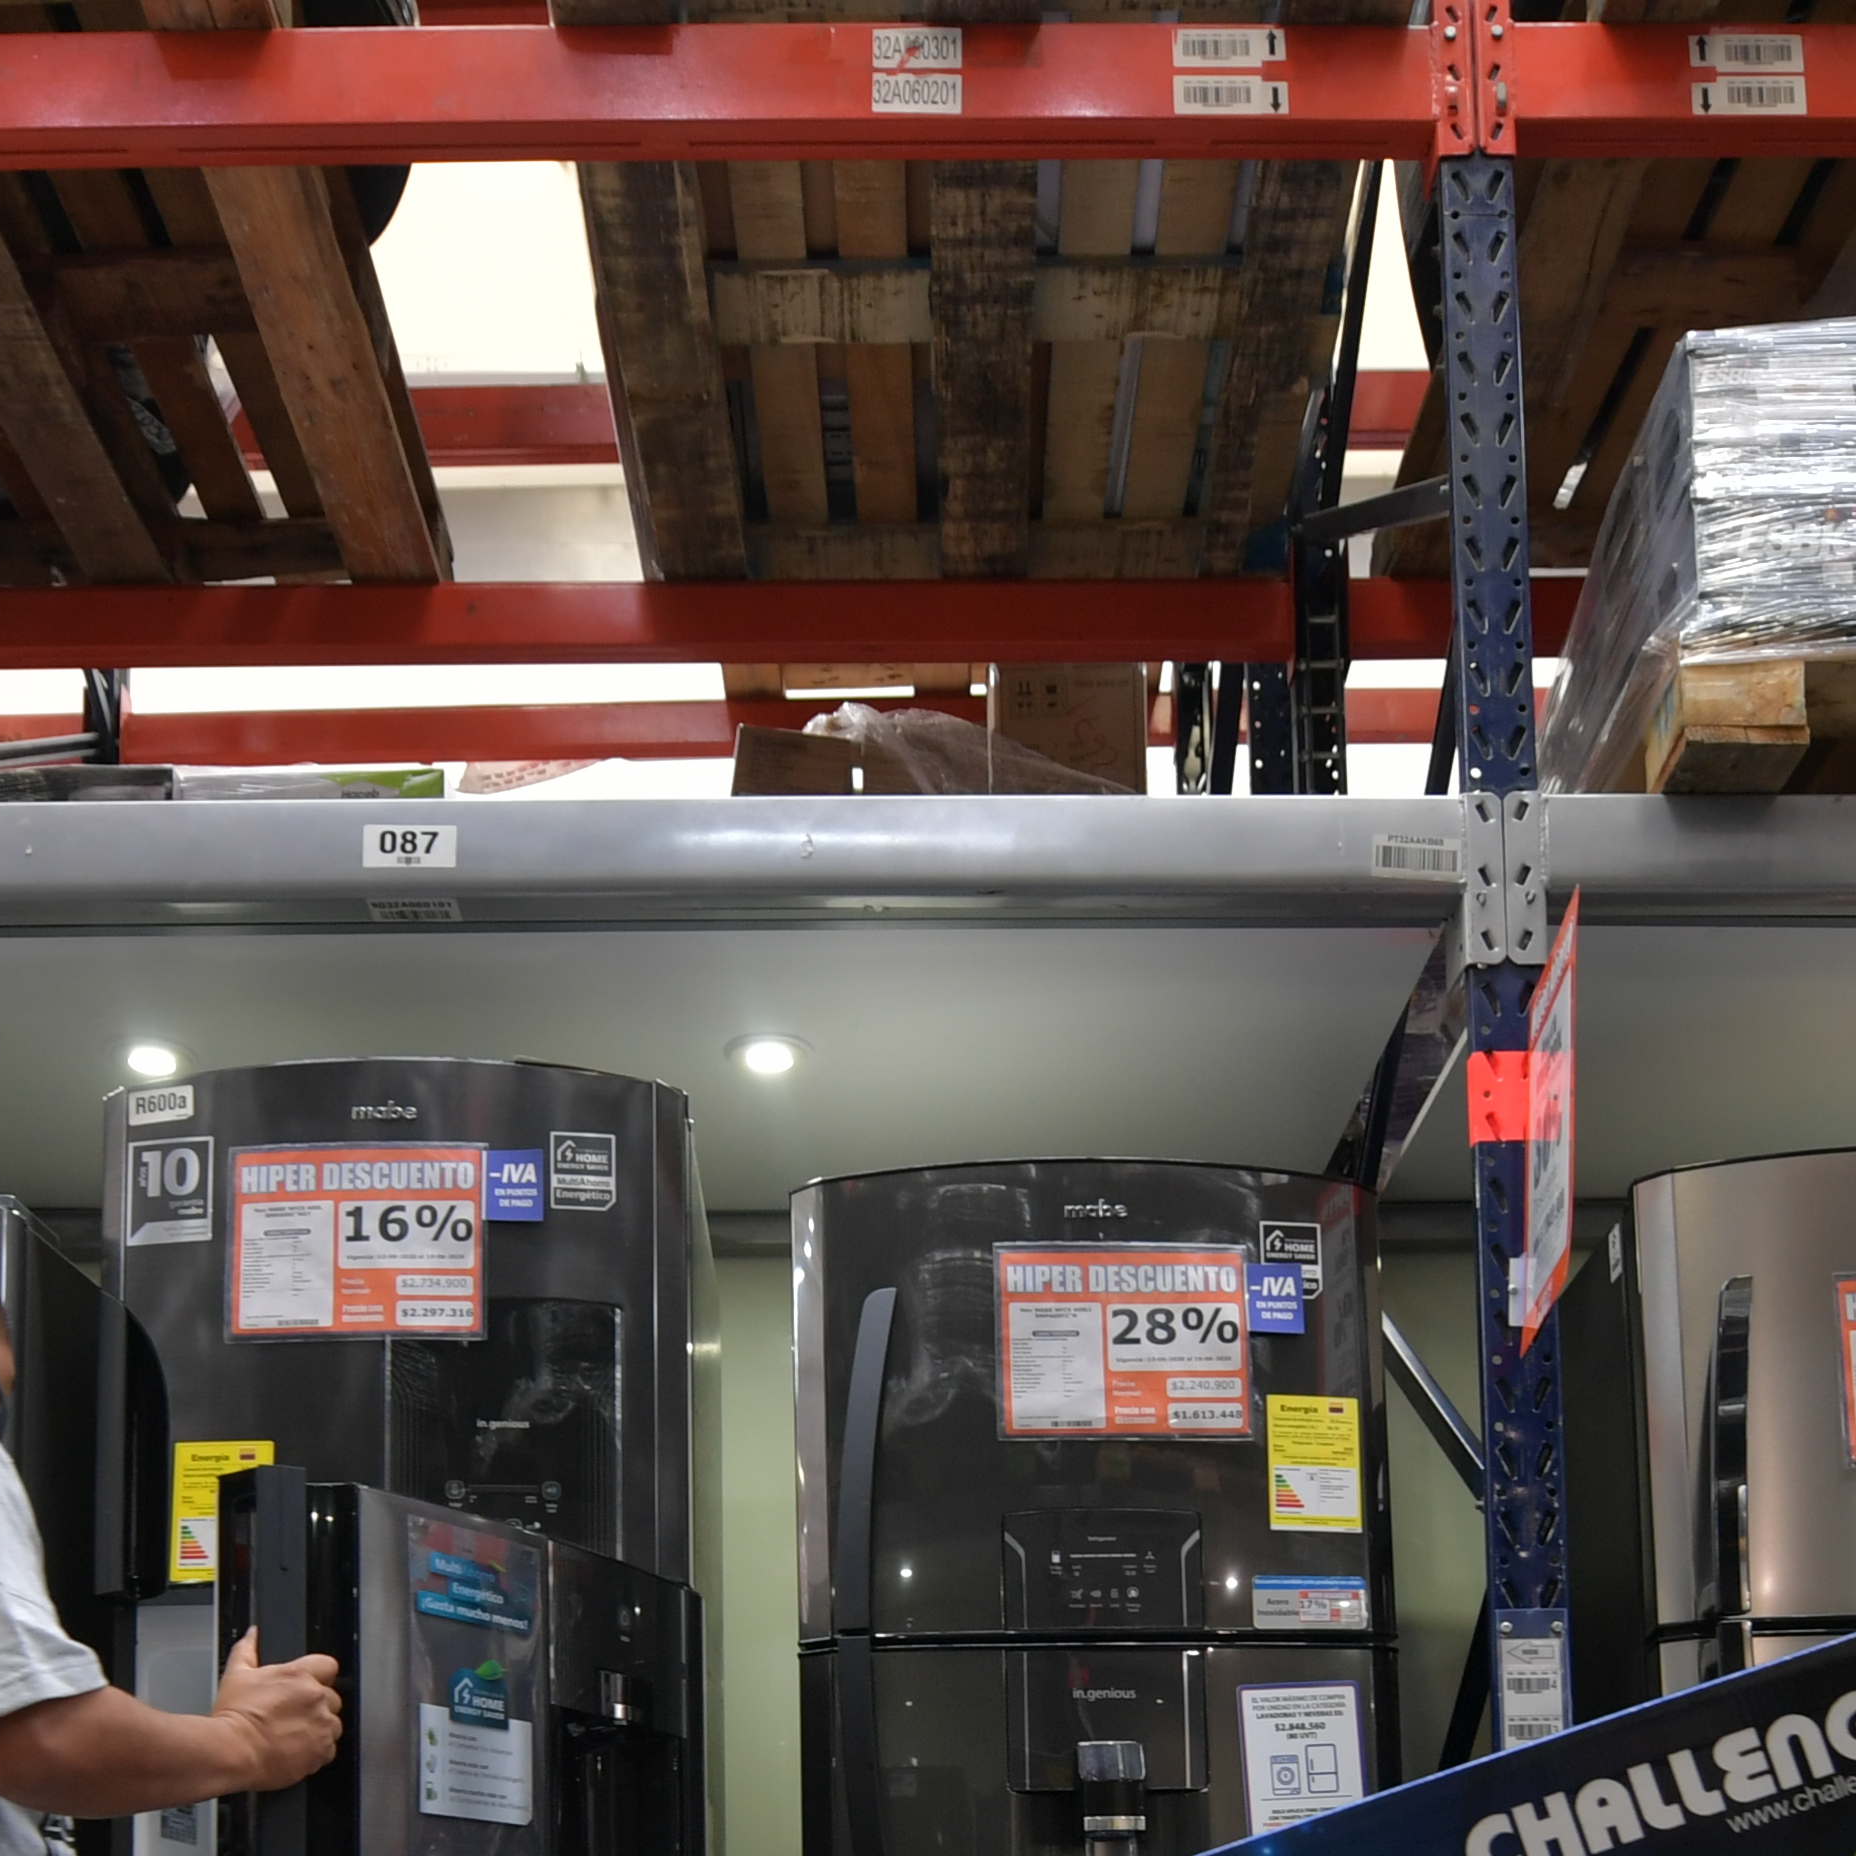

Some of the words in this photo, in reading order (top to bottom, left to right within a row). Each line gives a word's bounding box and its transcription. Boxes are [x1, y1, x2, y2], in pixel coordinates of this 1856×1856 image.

[873, 79, 958, 105] 32A060201
[379, 830, 439, 854] 087
[135, 1092, 187, 1115] R600a
[351, 1101, 418, 1121] mabe
[576, 1154, 609, 1163] HOME
[141, 1148, 200, 1197] 10
[241, 1163, 316, 1194] HIPER
[323, 1162, 475, 1191] DESCUENTO
[489, 1163, 537, 1184] -IVA
[557, 1178, 610, 1187] MultiAhorro
[556, 1189, 611, 1201] Energético
[1064, 1199, 1129, 1219] mabe
[345, 1205, 473, 1243] 16%
[1284, 1241, 1316, 1254] HOME
[401, 1277, 467, 1289] $2.734.900
[1006, 1265, 1083, 1293] HIPER
[1088, 1264, 1237, 1294] DESCUENTO
[1249, 1276, 1297, 1298] -IVA
[401, 1307, 474, 1318] $2.297.316
[1267, 1302, 1298, 1310] PUNTOS
[1271, 1311, 1294, 1320] PAGO
[1111, 1307, 1239, 1345] 28%
[1172, 1380, 1235, 1391] $2.240.900
[1173, 1410, 1243, 1420] $1.613.448
[1280, 1403, 1319, 1415] Energía
[453, 1582, 504, 1604] Energético
[1300, 1600, 1327, 1609] 17%
[457, 1607, 490, 1620] mucho
[1072, 1687, 1137, 1701] in.genious
[472, 1697, 506, 1712] HOME
